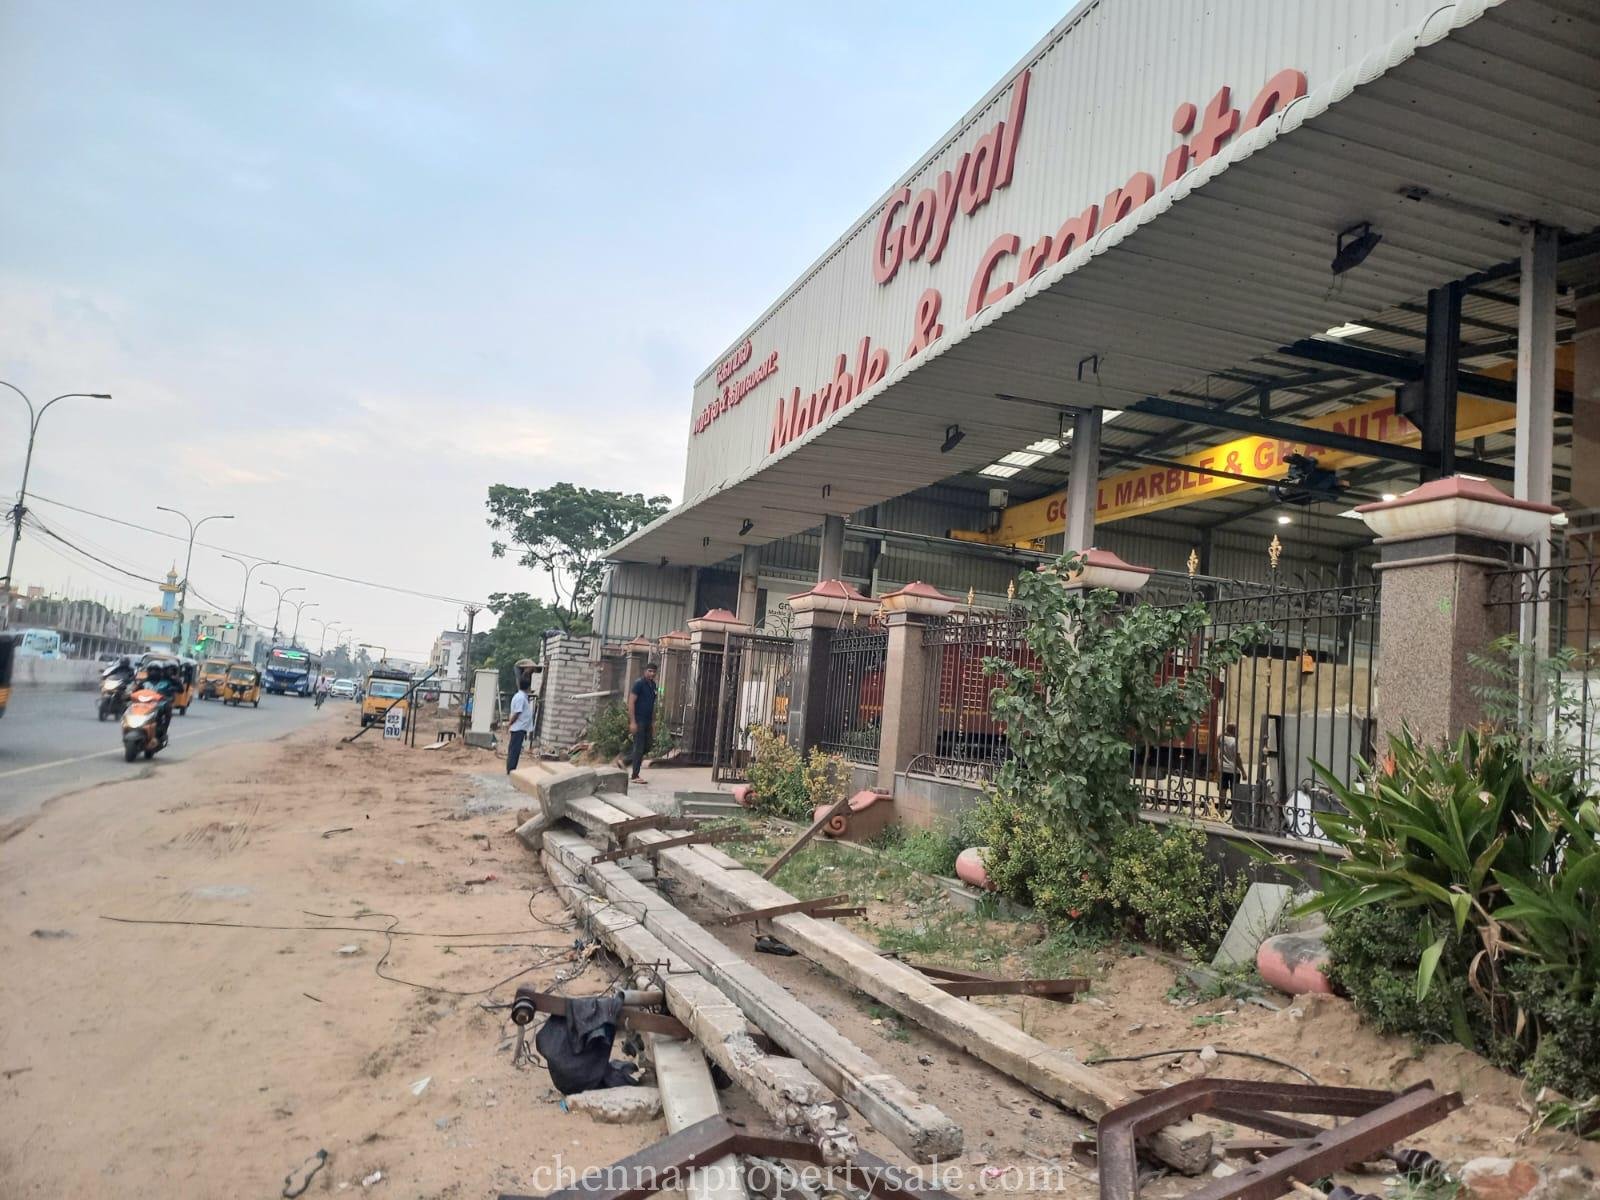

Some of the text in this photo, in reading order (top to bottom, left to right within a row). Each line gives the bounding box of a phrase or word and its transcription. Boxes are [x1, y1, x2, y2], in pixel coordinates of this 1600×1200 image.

[873, 70, 1031, 285] Goyal
[770, 336, 890, 454] Marble
[904, 288, 944, 362] &
[1046, 405, 1409, 523] GOL MARBLE & GRNIT
